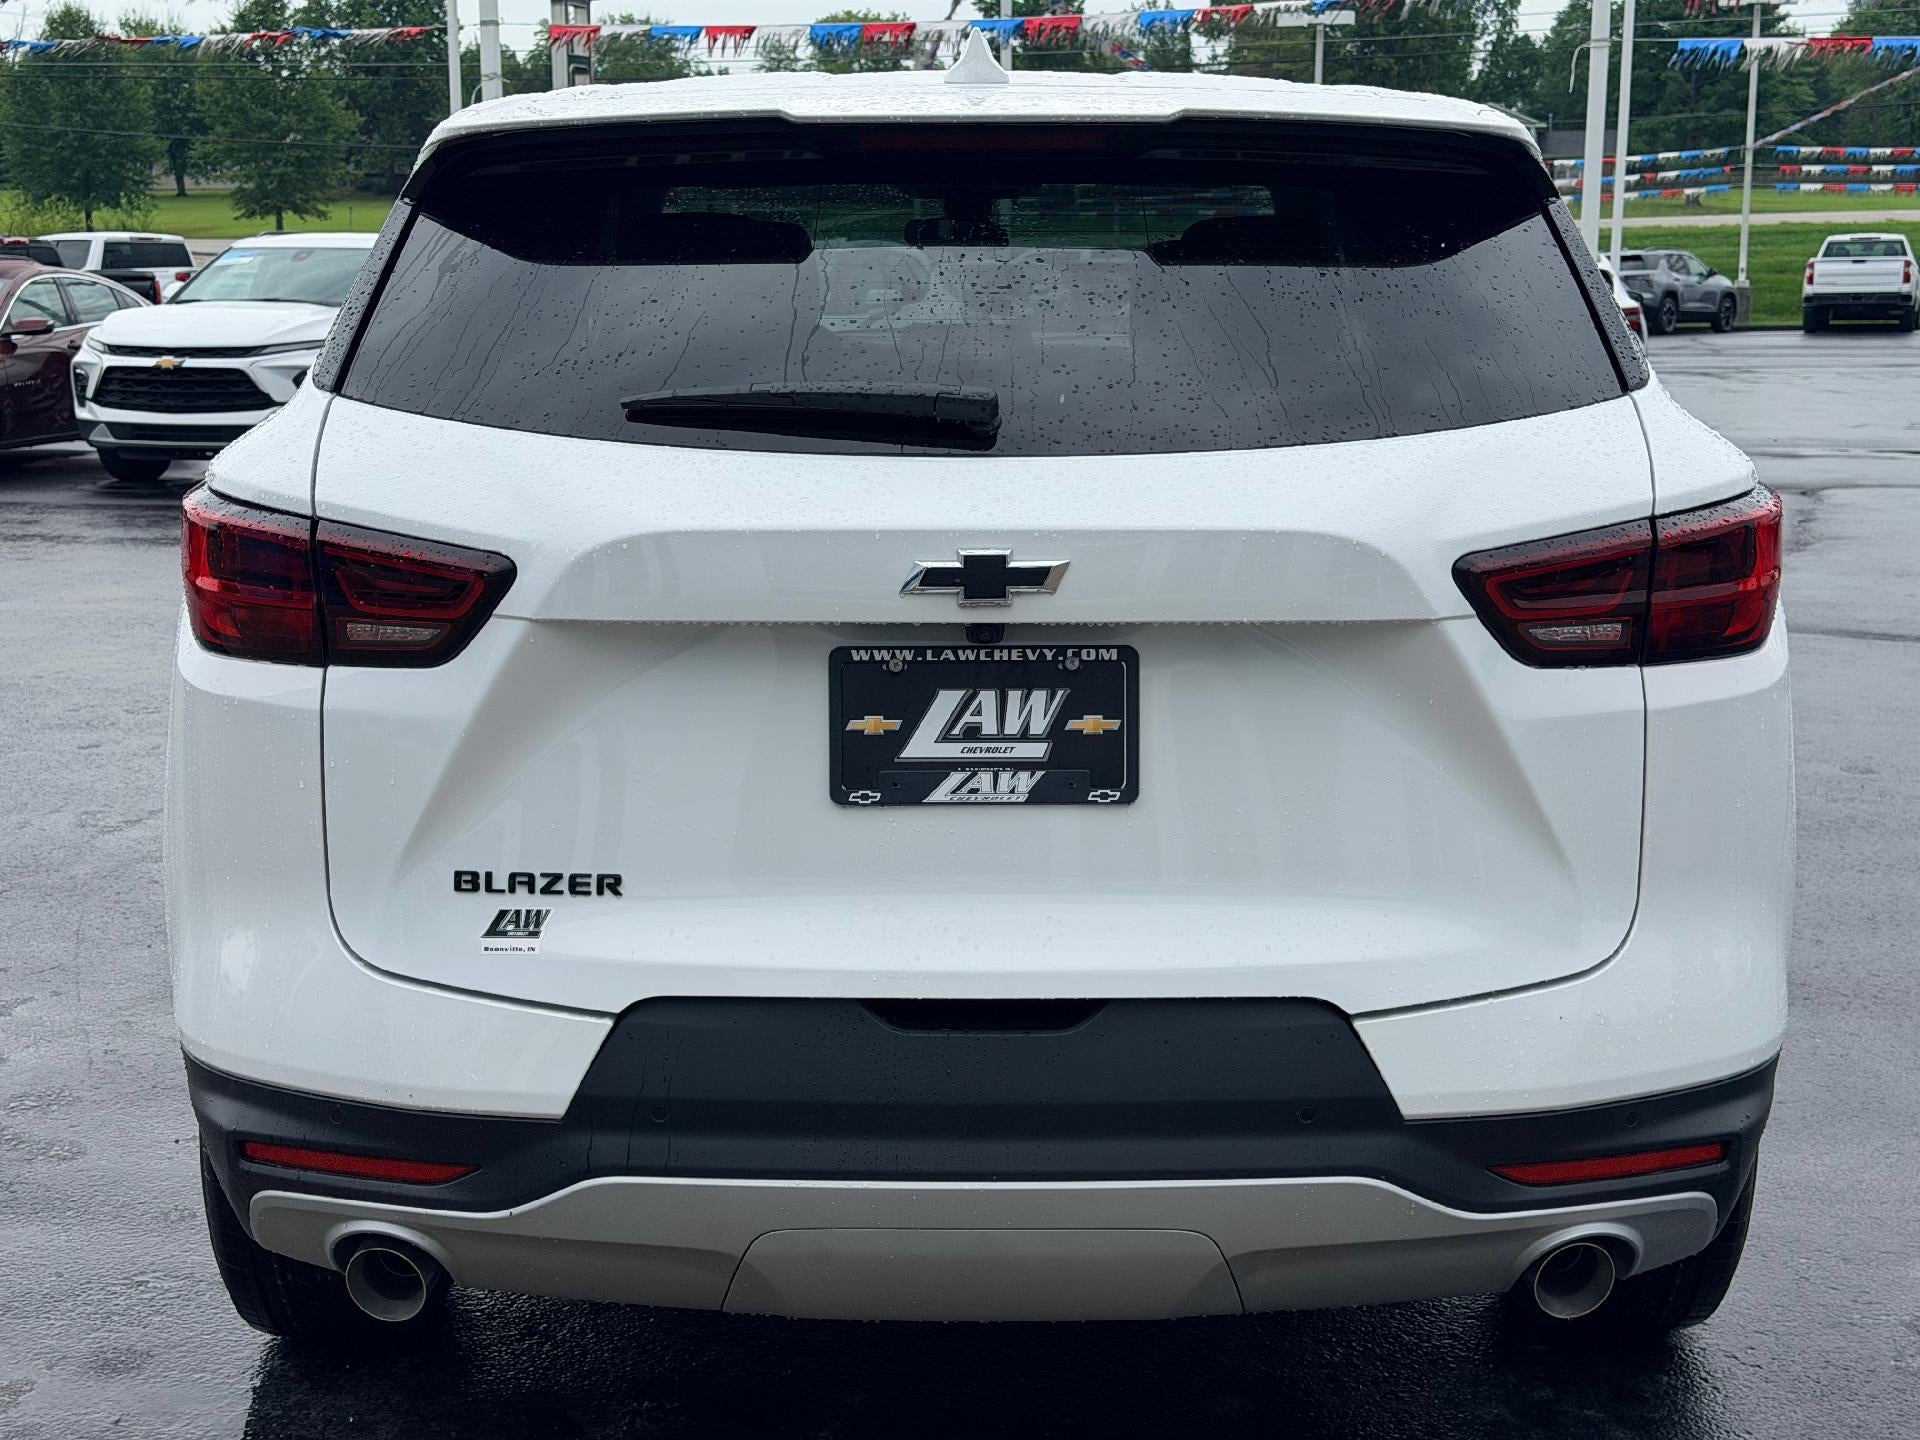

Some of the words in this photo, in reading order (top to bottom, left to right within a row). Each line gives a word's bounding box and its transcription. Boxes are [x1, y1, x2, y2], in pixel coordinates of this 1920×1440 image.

[850, 648, 1118, 661] WWW.LAWCHEVY.COM
[894, 688, 1071, 762] LAW
[960, 746, 1016, 754] CHEVROLET
[922, 771, 1046, 802] LAW
[454, 870, 623, 896] BLAZER
[481, 909, 551, 938] LAW
